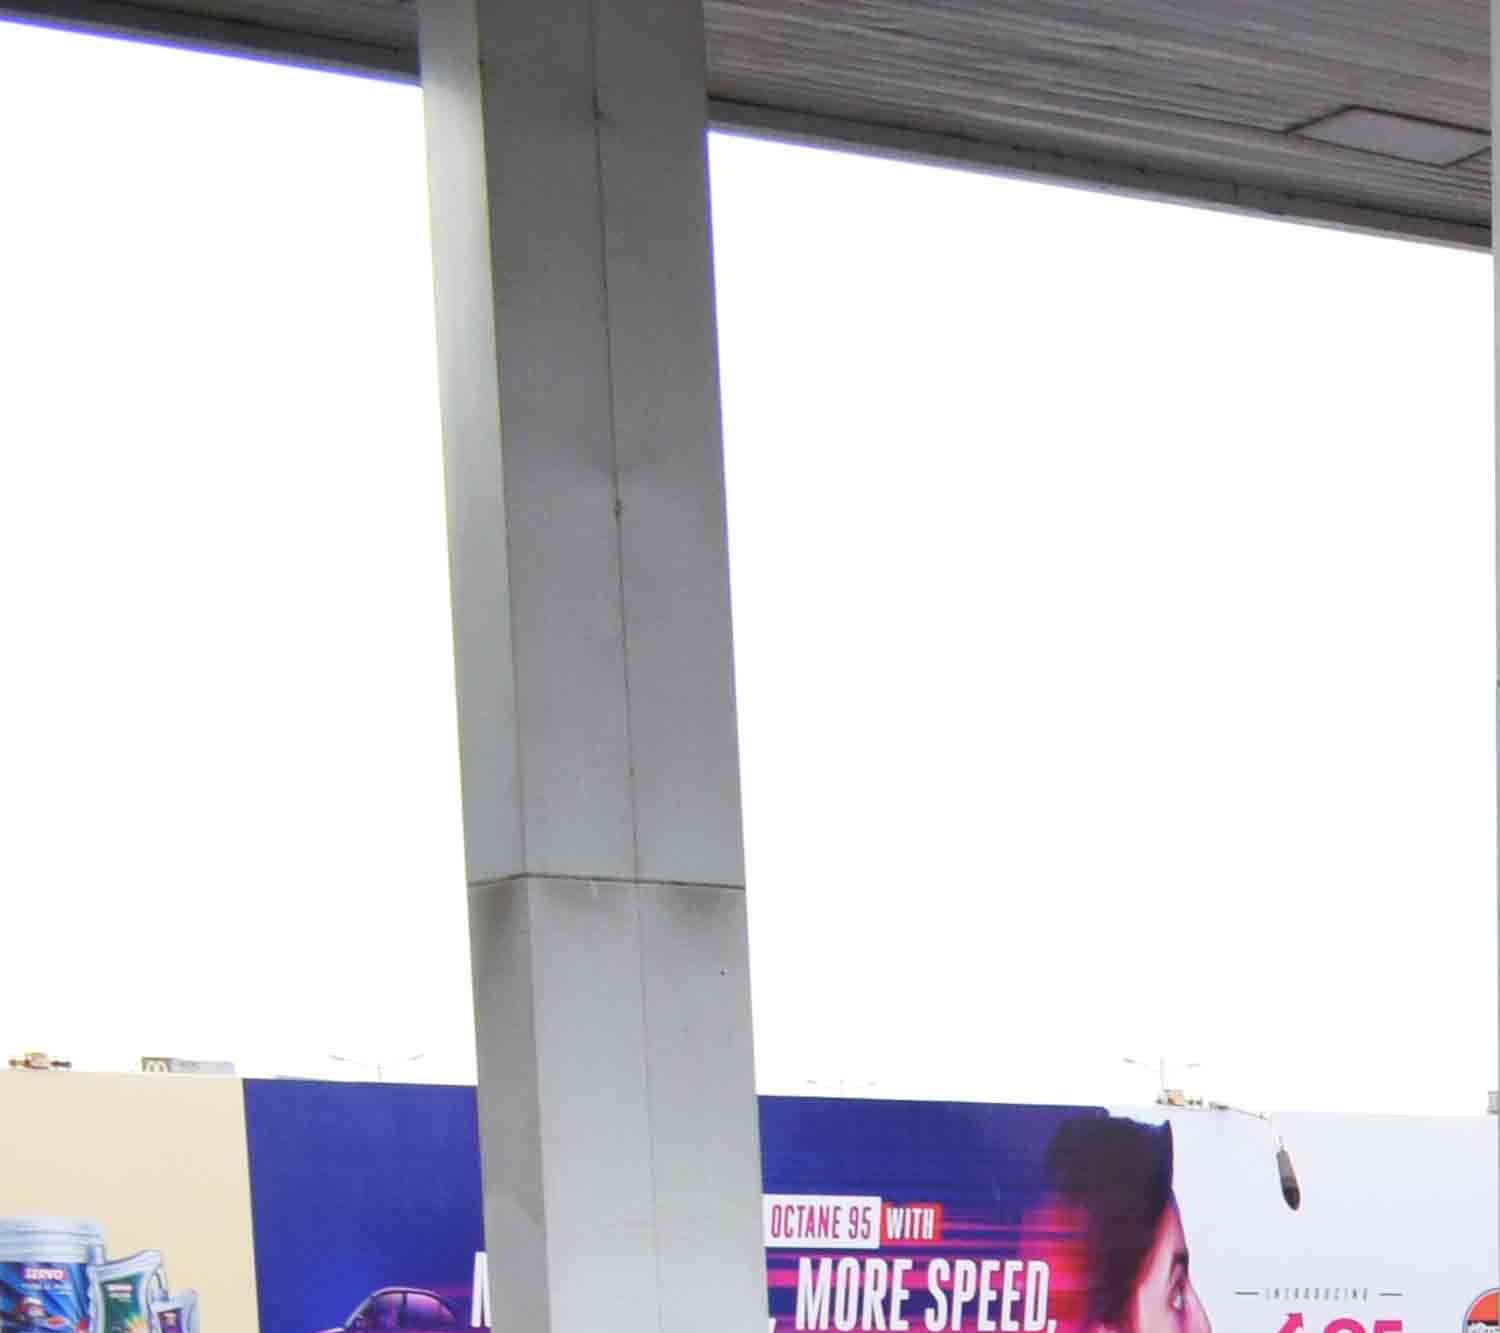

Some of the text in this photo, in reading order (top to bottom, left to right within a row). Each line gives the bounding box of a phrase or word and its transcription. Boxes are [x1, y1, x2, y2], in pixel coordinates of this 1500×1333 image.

[771, 1204, 936, 1240] OCTANE 95 WITH
[795, 1256, 913, 1332] MORE
